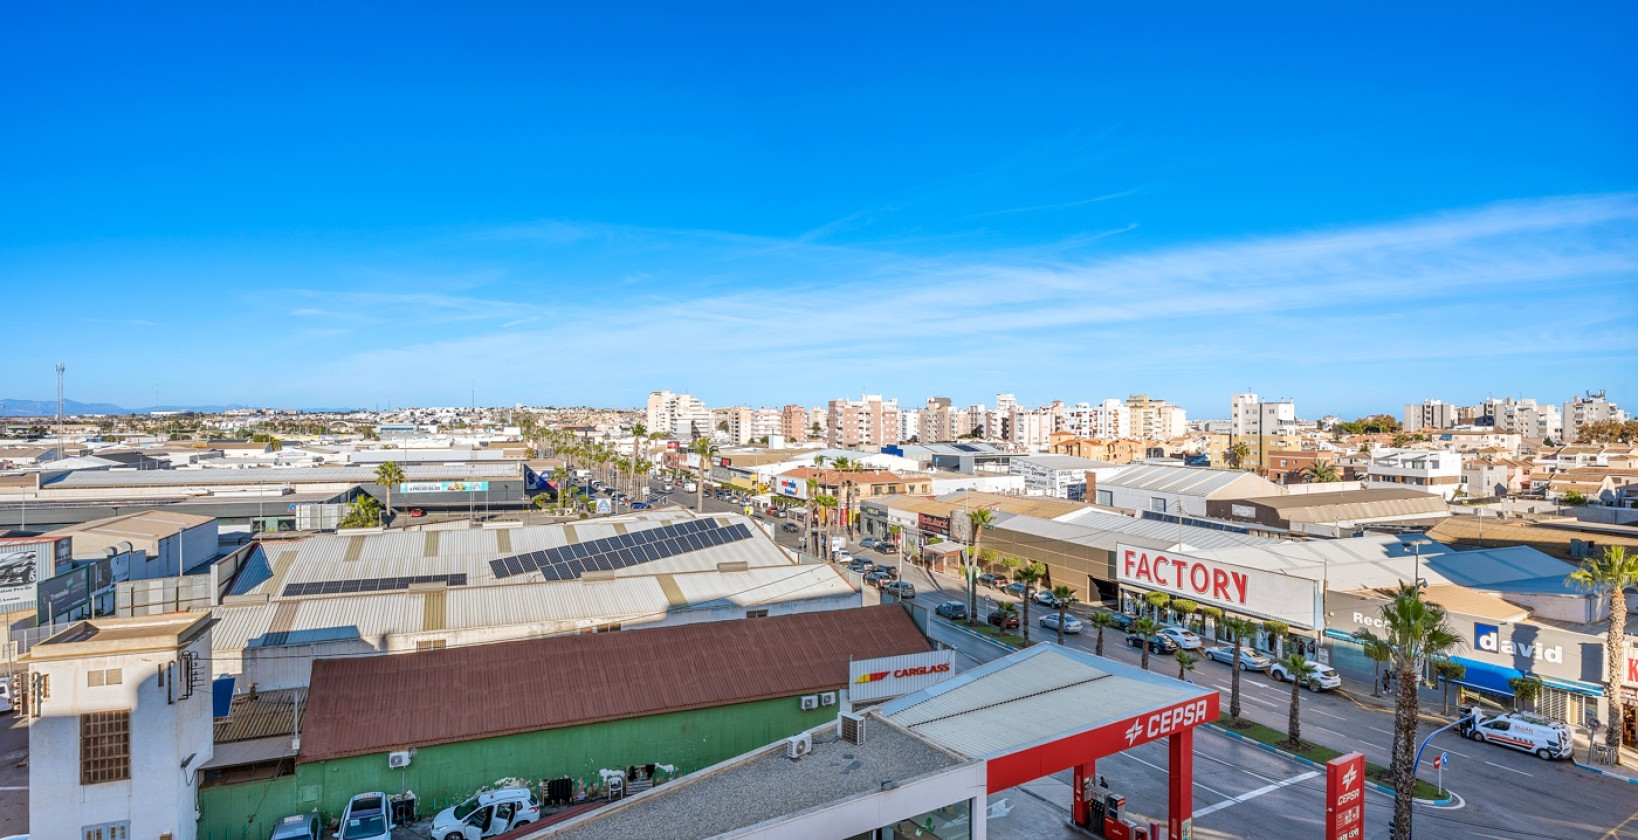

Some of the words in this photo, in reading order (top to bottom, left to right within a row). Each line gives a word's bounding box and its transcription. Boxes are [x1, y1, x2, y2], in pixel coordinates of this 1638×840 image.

[1125, 550, 1247, 605] FACTORY
[1479, 632, 1563, 664] david
[893, 663, 950, 678] CARGLASS
[1147, 699, 1207, 738] CEPSA
[1337, 788, 1360, 806] CEPSA
